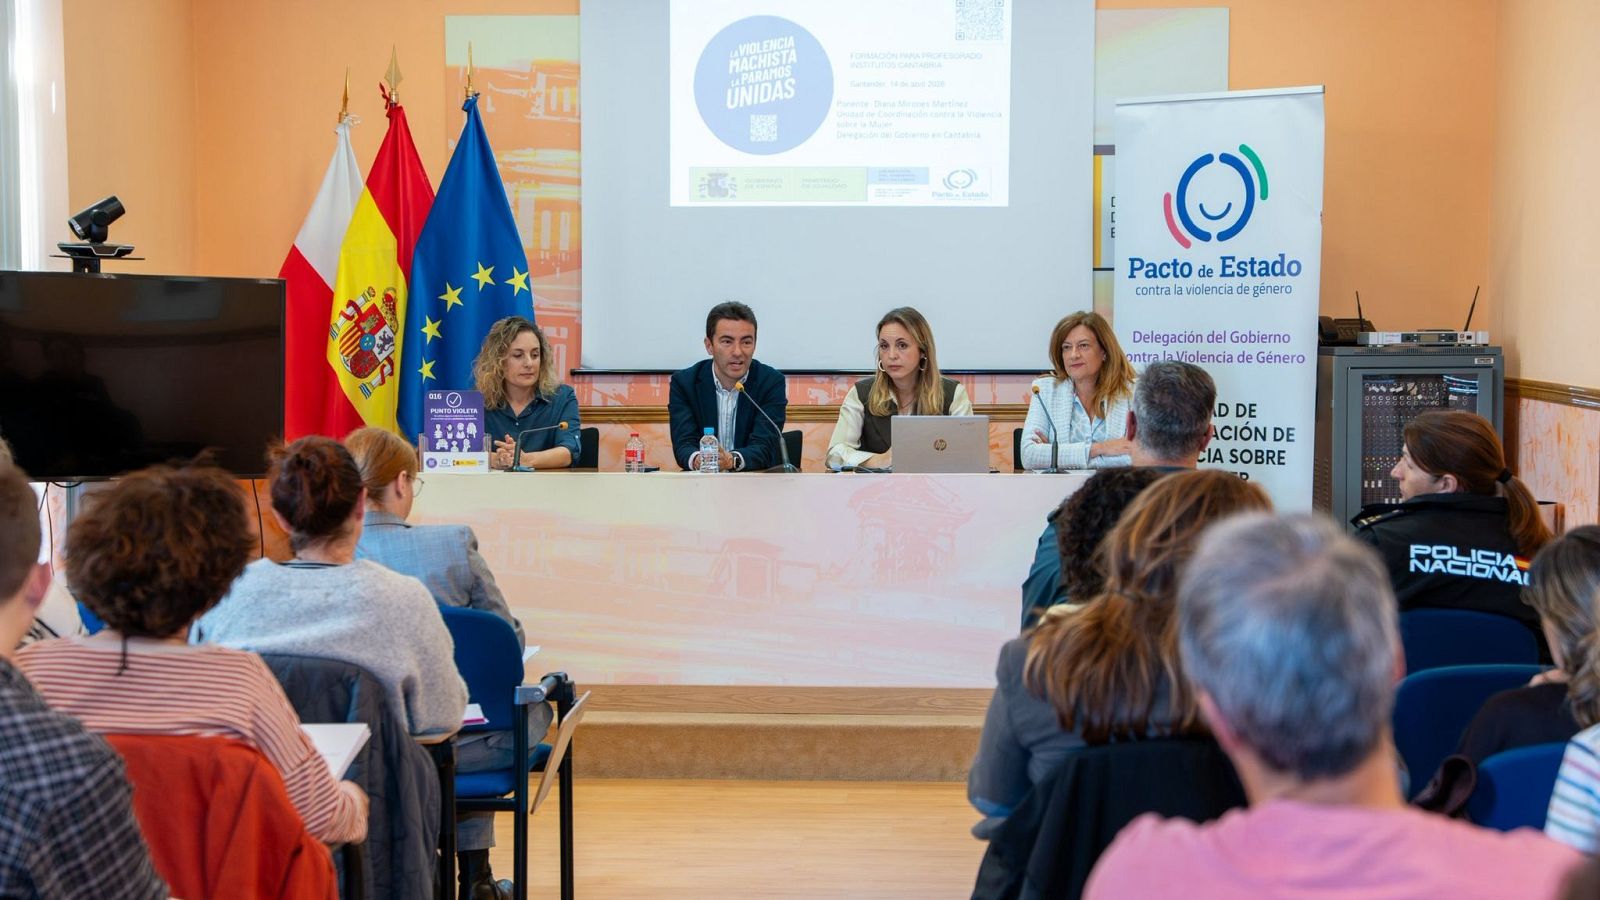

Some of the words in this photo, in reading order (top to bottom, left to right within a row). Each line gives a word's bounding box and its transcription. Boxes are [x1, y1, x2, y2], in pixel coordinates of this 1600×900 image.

[730, 50, 739, 58] LA
[738, 35, 795, 57] VIOLENCIA
[729, 48, 797, 75] MACHISTA
[850, 51, 898, 60] FORMACIÓN
[899, 52, 921, 60] PARA
[922, 52, 983, 60] PROFESORADO
[731, 78, 740, 87] LA
[741, 65, 792, 85] PARAMOS
[910, 80, 926, 88] abril
[727, 78, 796, 109] UNIDAS
[874, 100, 896, 108] Diana
[932, 99, 968, 108] Martínez
[836, 111, 864, 119] Unidad
[877, 109, 928, 118] Coordinación
[930, 111, 955, 119] contra
[957, 110, 964, 118] la
[966, 110, 1002, 119] Violencia
[869, 121, 893, 131] Mujer
[836, 130, 879, 141] Delegación
[880, 131, 893, 139] del
[894, 130, 930, 139] Gobierno
[943, 130, 981, 139] Cantabria
[1127, 257, 1193, 279] Pacto
[1198, 265, 1213, 278] de
[1219, 253, 1302, 278] Estado
[1135, 284, 1171, 296] contra
[1174, 283, 1183, 295] la
[1186, 283, 1233, 296] violencia
[1236, 283, 1250, 295] de
[1252, 281, 1293, 298] género
[1132, 330, 1203, 347] Delegación
[1206, 330, 1227, 344] del
[1230, 330, 1291, 344] Gobierno
[1162, 350, 1173, 362] la
[1175, 350, 1233, 364] Violencia
[1236, 351, 1253, 364] de
[1256, 351, 1305, 364] Género
[1235, 403, 1257, 418] DE
[1273, 427, 1295, 442] DE
[1229, 448, 1286, 465] SOBRE
[1410, 544, 1518, 569] POLICIA
